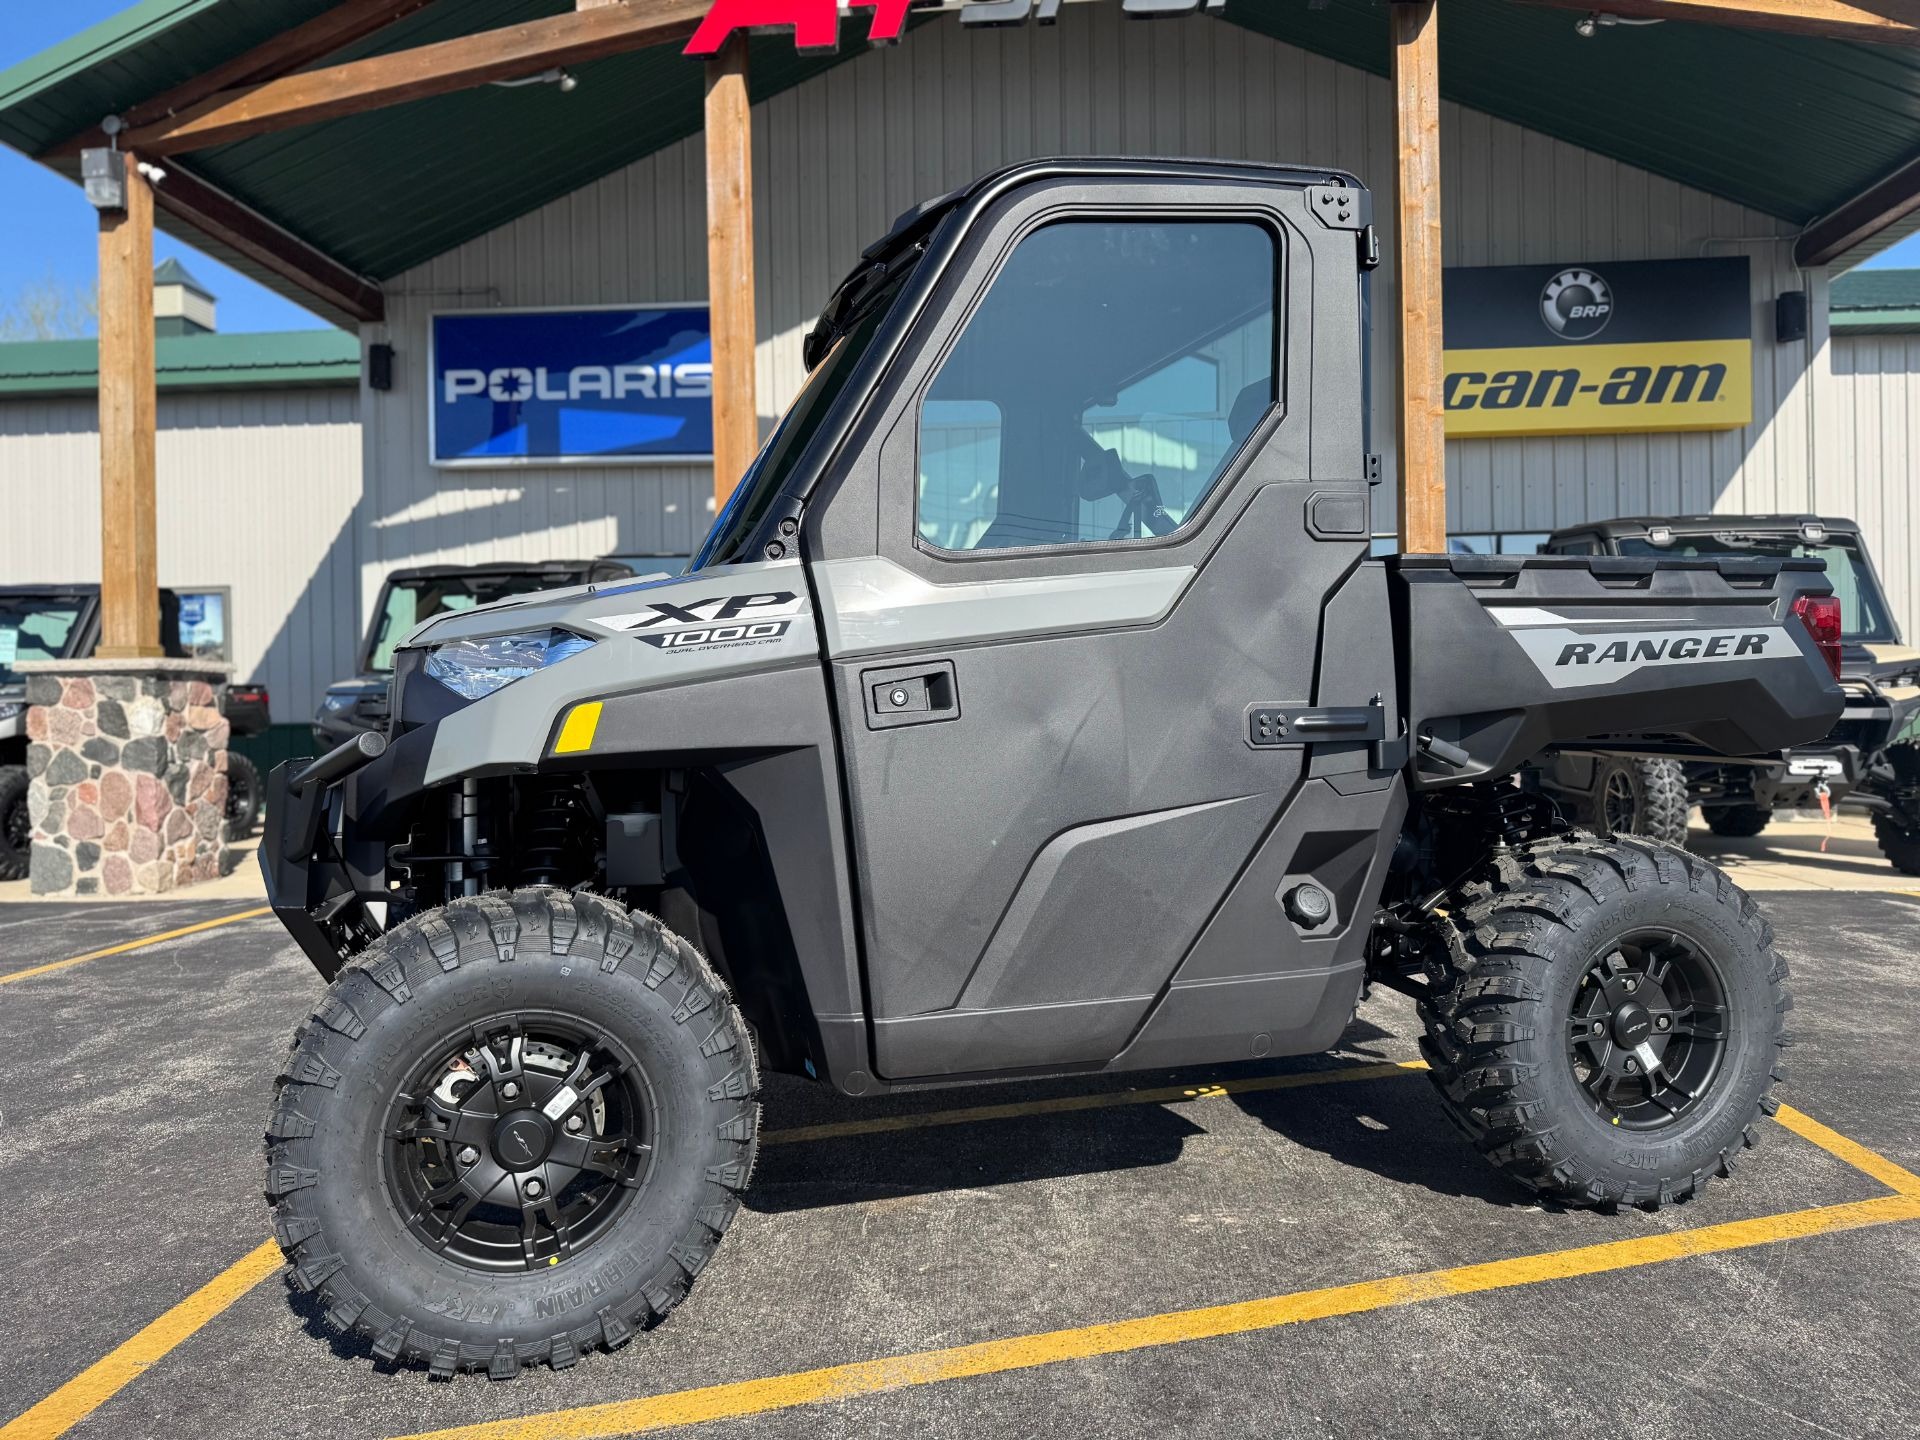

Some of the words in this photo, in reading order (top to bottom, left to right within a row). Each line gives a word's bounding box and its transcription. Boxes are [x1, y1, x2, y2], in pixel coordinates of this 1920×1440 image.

[1569, 304, 1610, 318] BRP
[444, 364, 713, 403] POLARIS
[1443, 363, 1728, 411] can-am
[626, 591, 798, 629] XP
[661, 622, 782, 647] 1000
[665, 647, 695, 655] DUAL
[698, 640, 756, 651] OVERHEAD
[757, 638, 782, 646] CAM
[1555, 633, 1770, 666] RANGER
